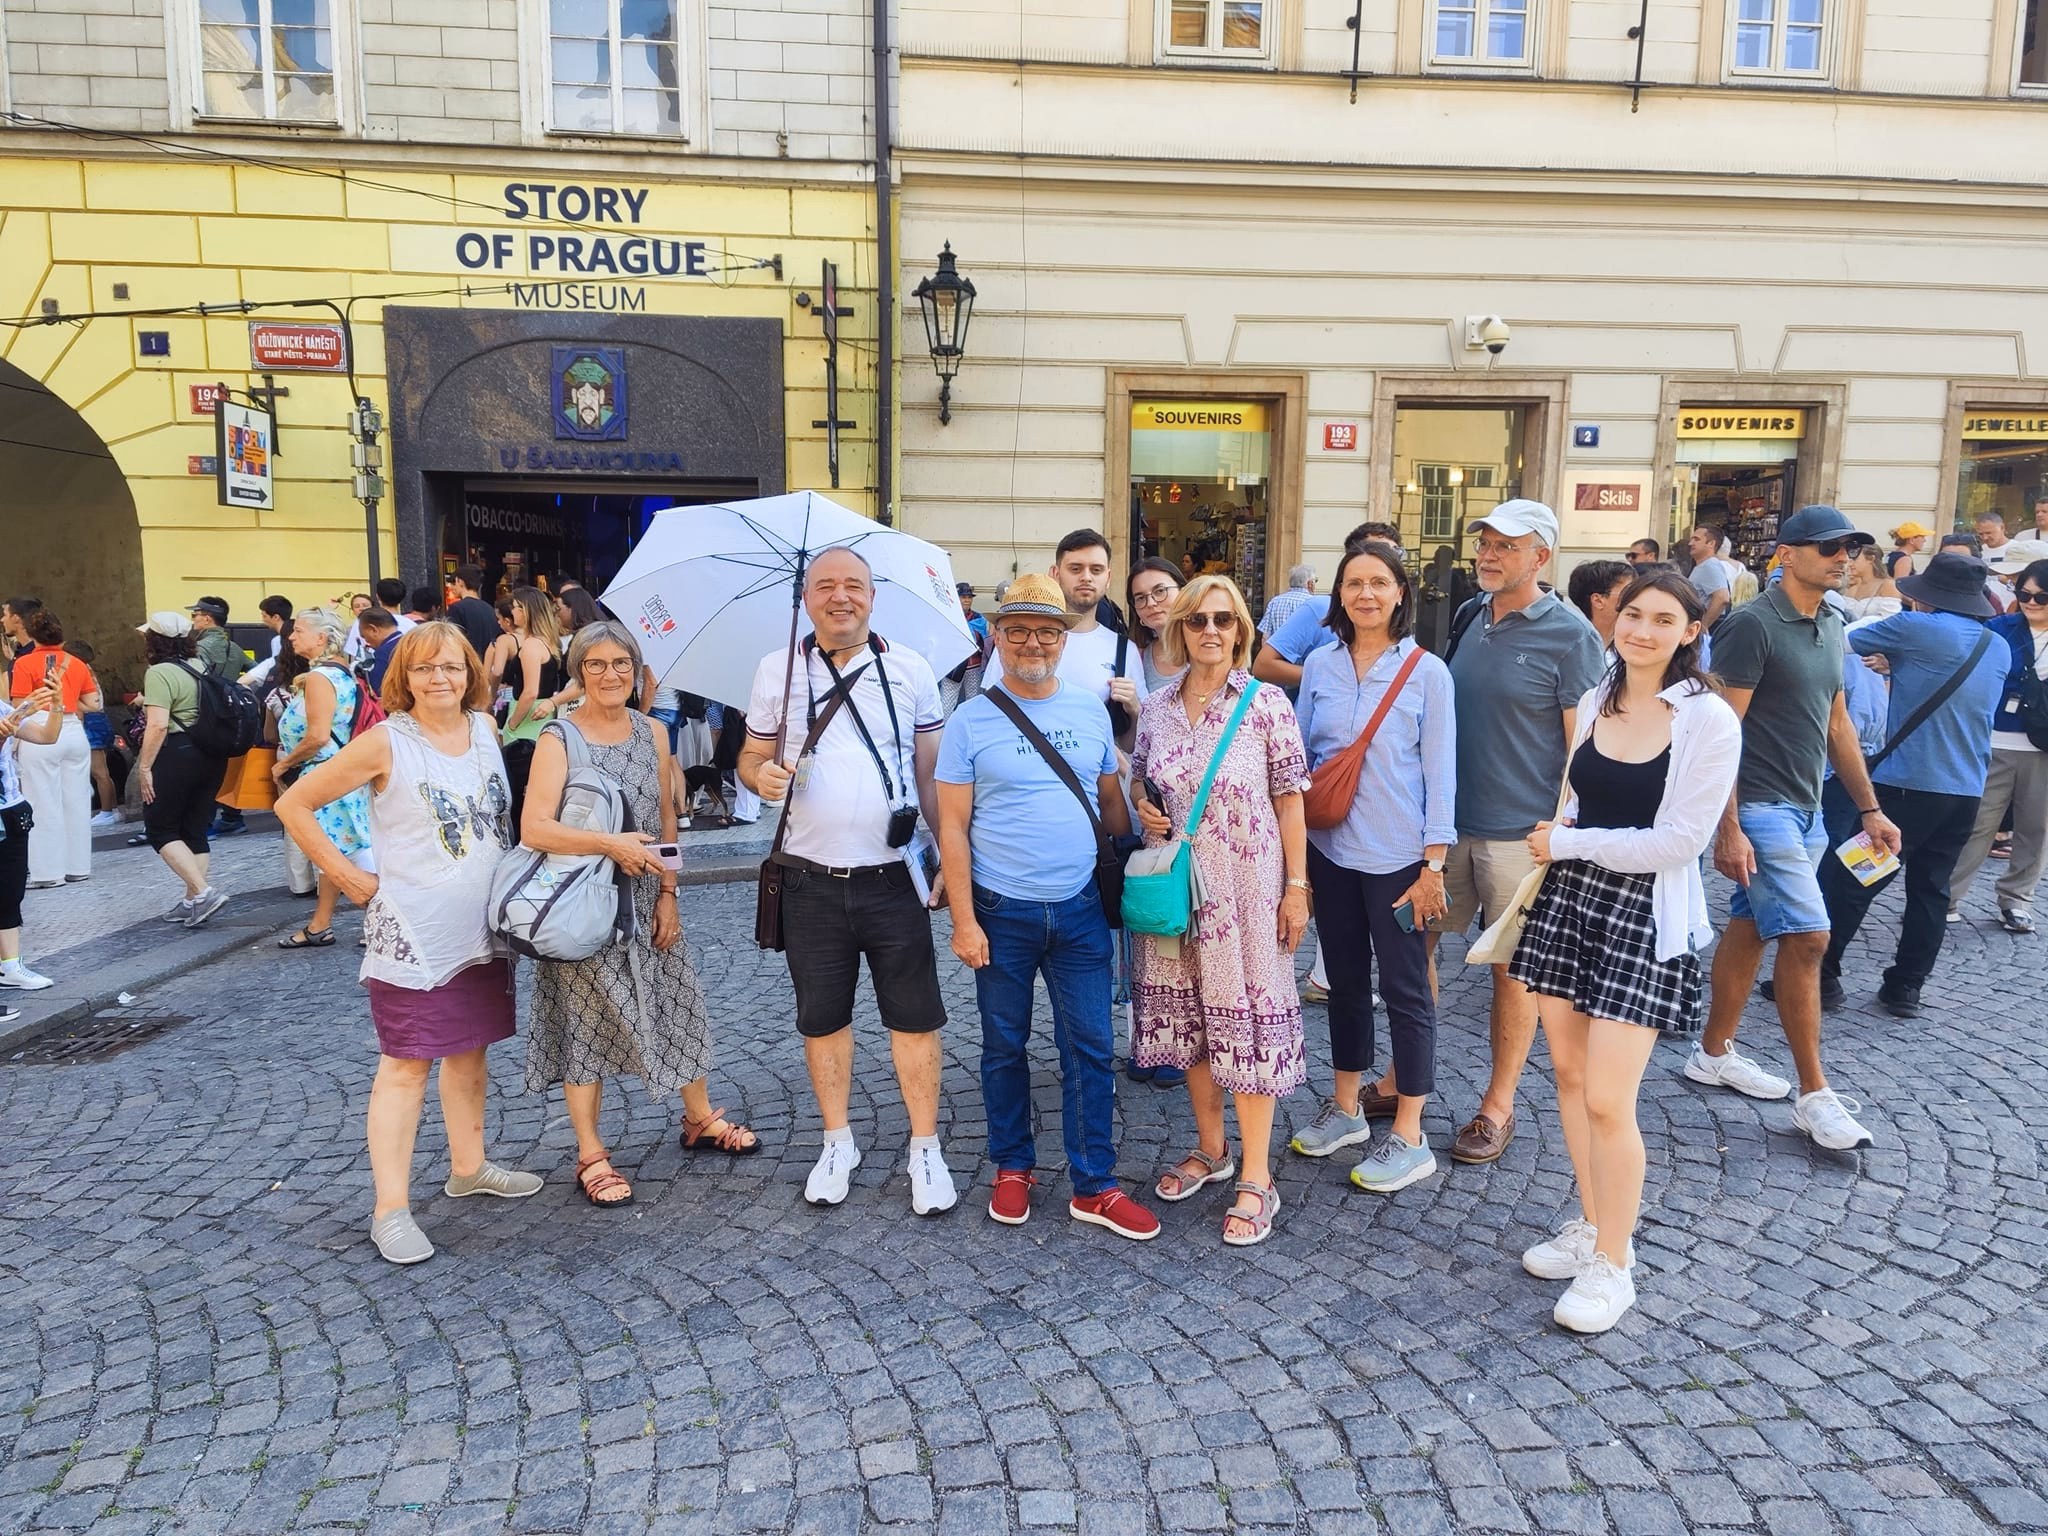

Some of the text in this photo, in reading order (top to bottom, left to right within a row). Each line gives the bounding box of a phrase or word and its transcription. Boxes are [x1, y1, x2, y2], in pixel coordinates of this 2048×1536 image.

[503, 182, 650, 224] STORY
[455, 232, 707, 277] OF PRAGUE
[513, 282, 648, 312] MUSEUM
[150, 336, 156, 350] 1
[197, 388, 219, 401] 194
[1155, 411, 1242, 425] SOUVENIRS
[1682, 417, 1795, 431] SOUVENIRS
[1331, 426, 1350, 439] 193
[1964, 418, 2048, 433] JEWELLE
[1584, 430, 1592, 443] 2
[1599, 489, 1633, 506] Skils
[1018, 729, 1072, 744] TMMY
